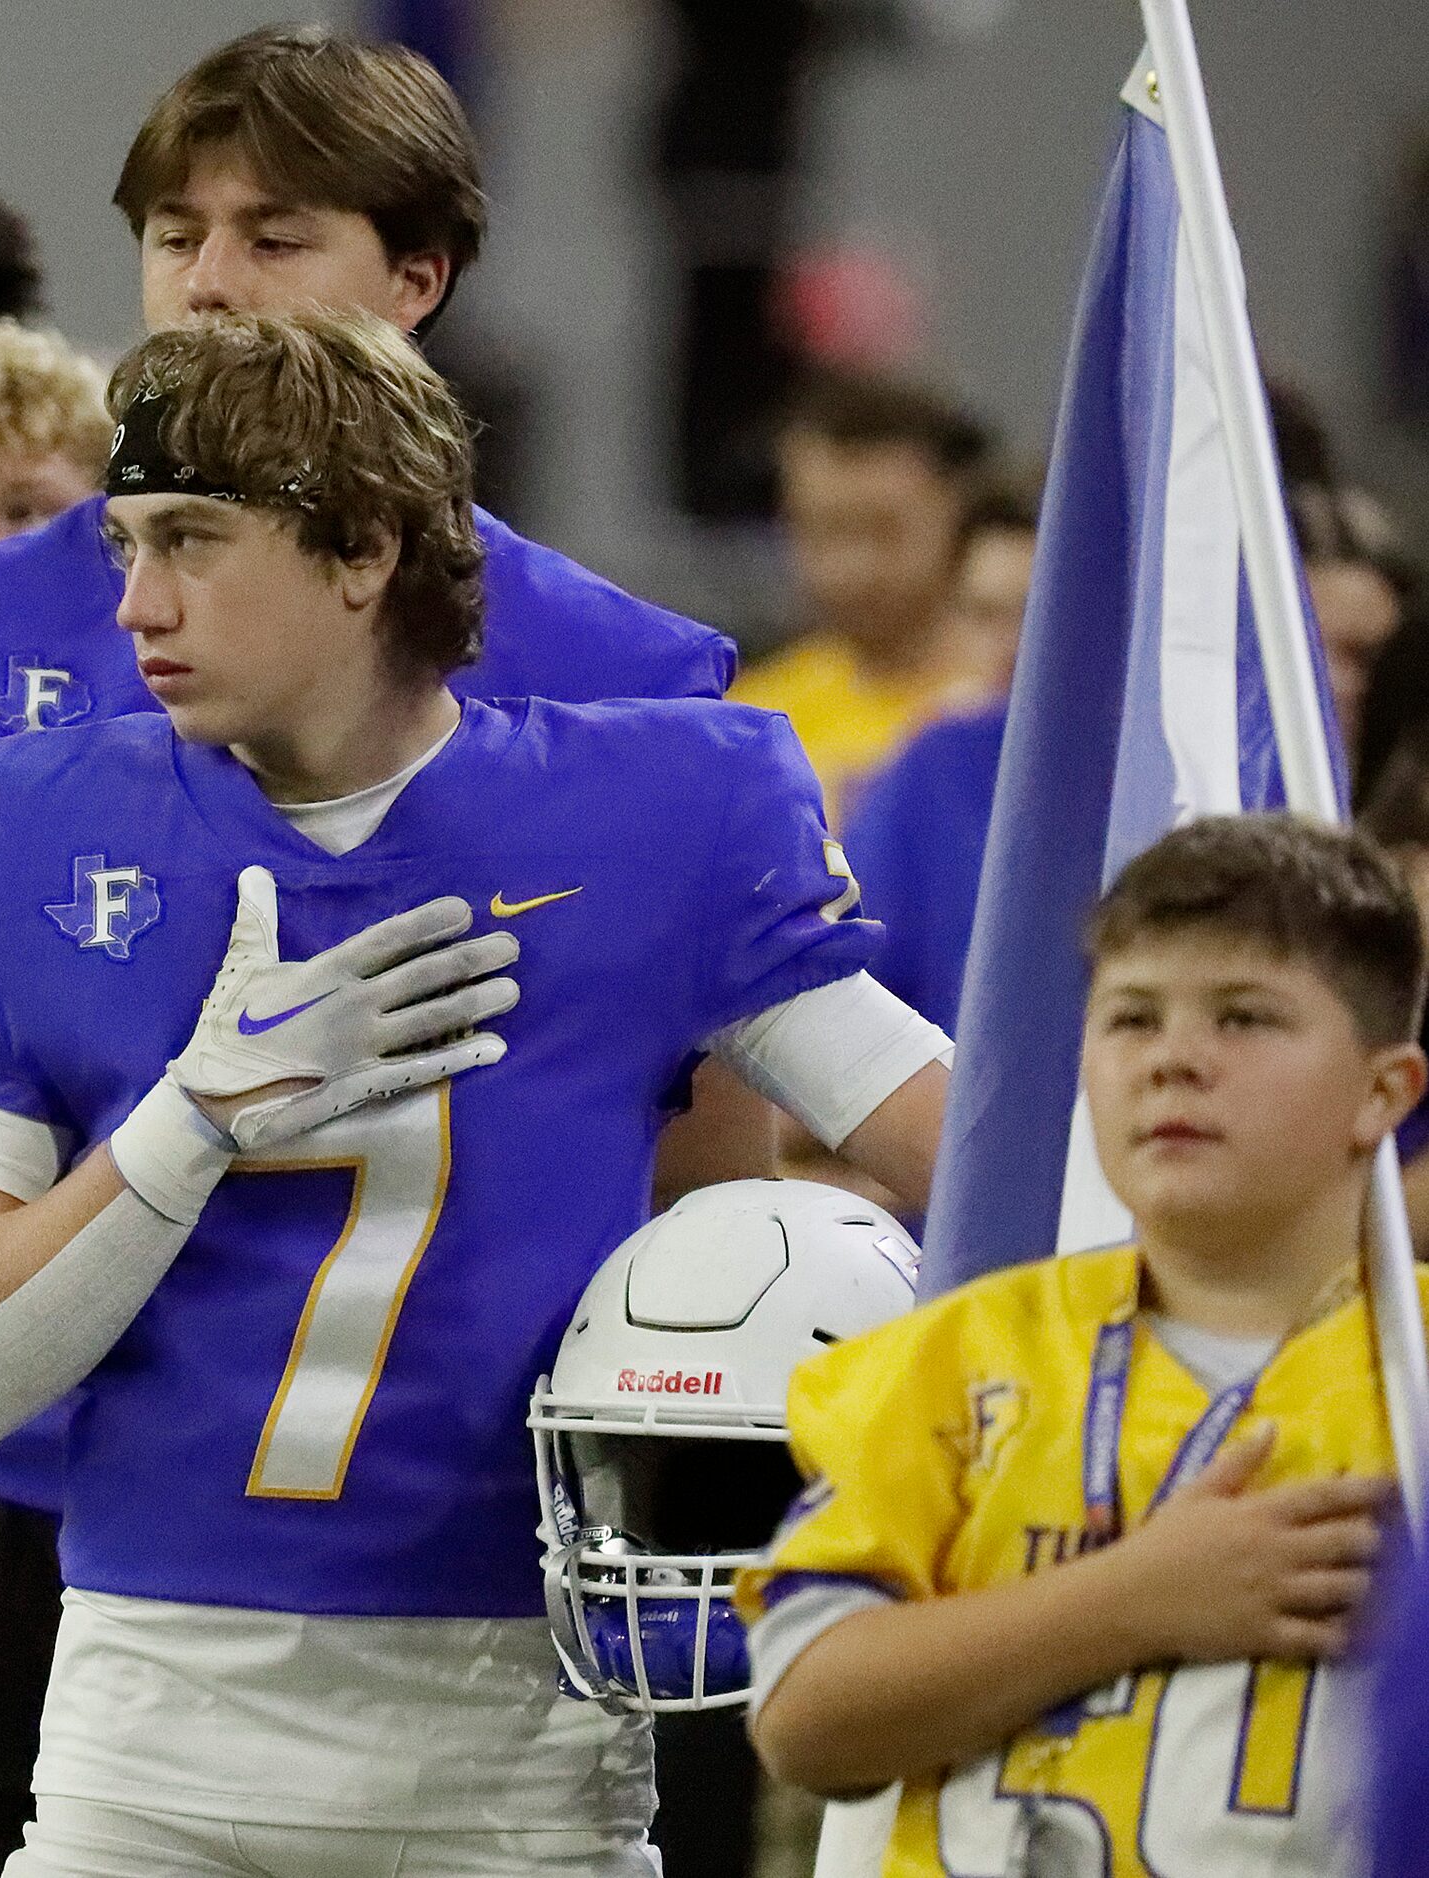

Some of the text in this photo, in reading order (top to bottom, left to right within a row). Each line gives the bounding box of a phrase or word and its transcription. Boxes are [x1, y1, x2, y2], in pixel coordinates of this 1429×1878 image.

[20, 667, 71, 732] F
[80, 865, 141, 948] F
[216, 1076, 453, 1500] 7
[617, 1367, 723, 1395] Riddell
